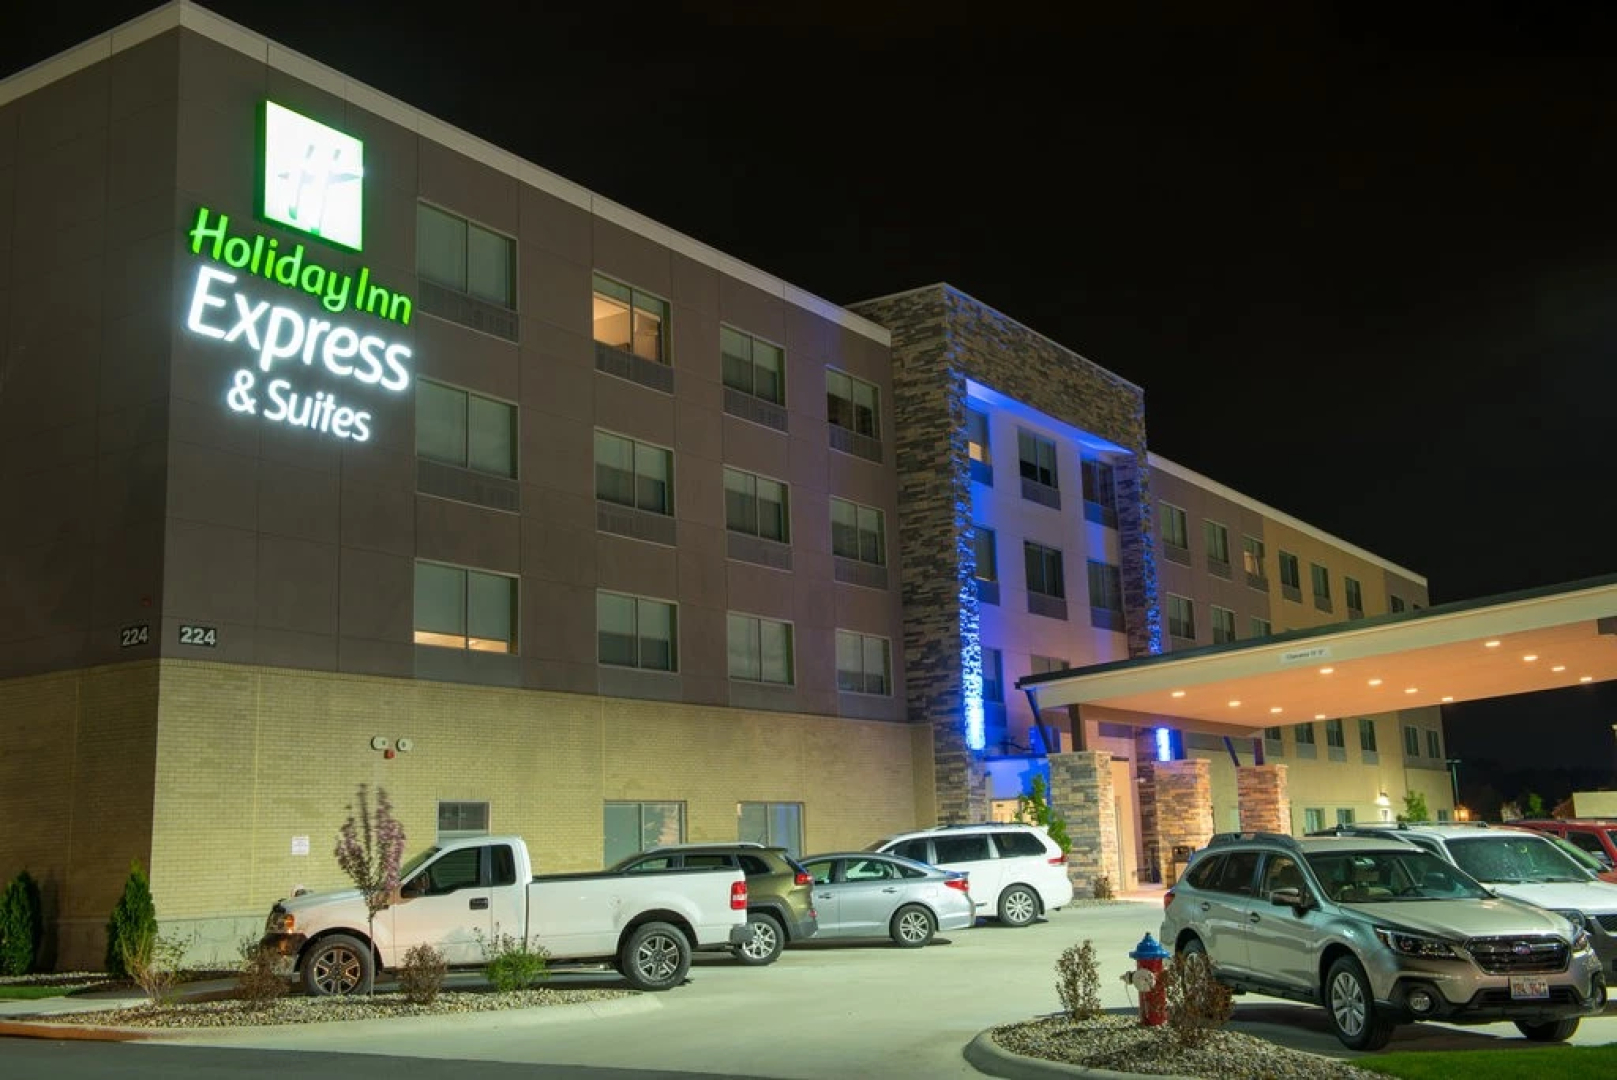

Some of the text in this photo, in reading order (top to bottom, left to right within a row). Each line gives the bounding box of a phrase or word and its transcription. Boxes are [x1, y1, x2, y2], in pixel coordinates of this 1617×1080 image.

[189, 207, 413, 326] Holiday Inn
[186, 265, 413, 392] Express
[226, 368, 372, 443] & Suites
[122, 626, 148, 647] 224
[181, 626, 216, 645] 224
